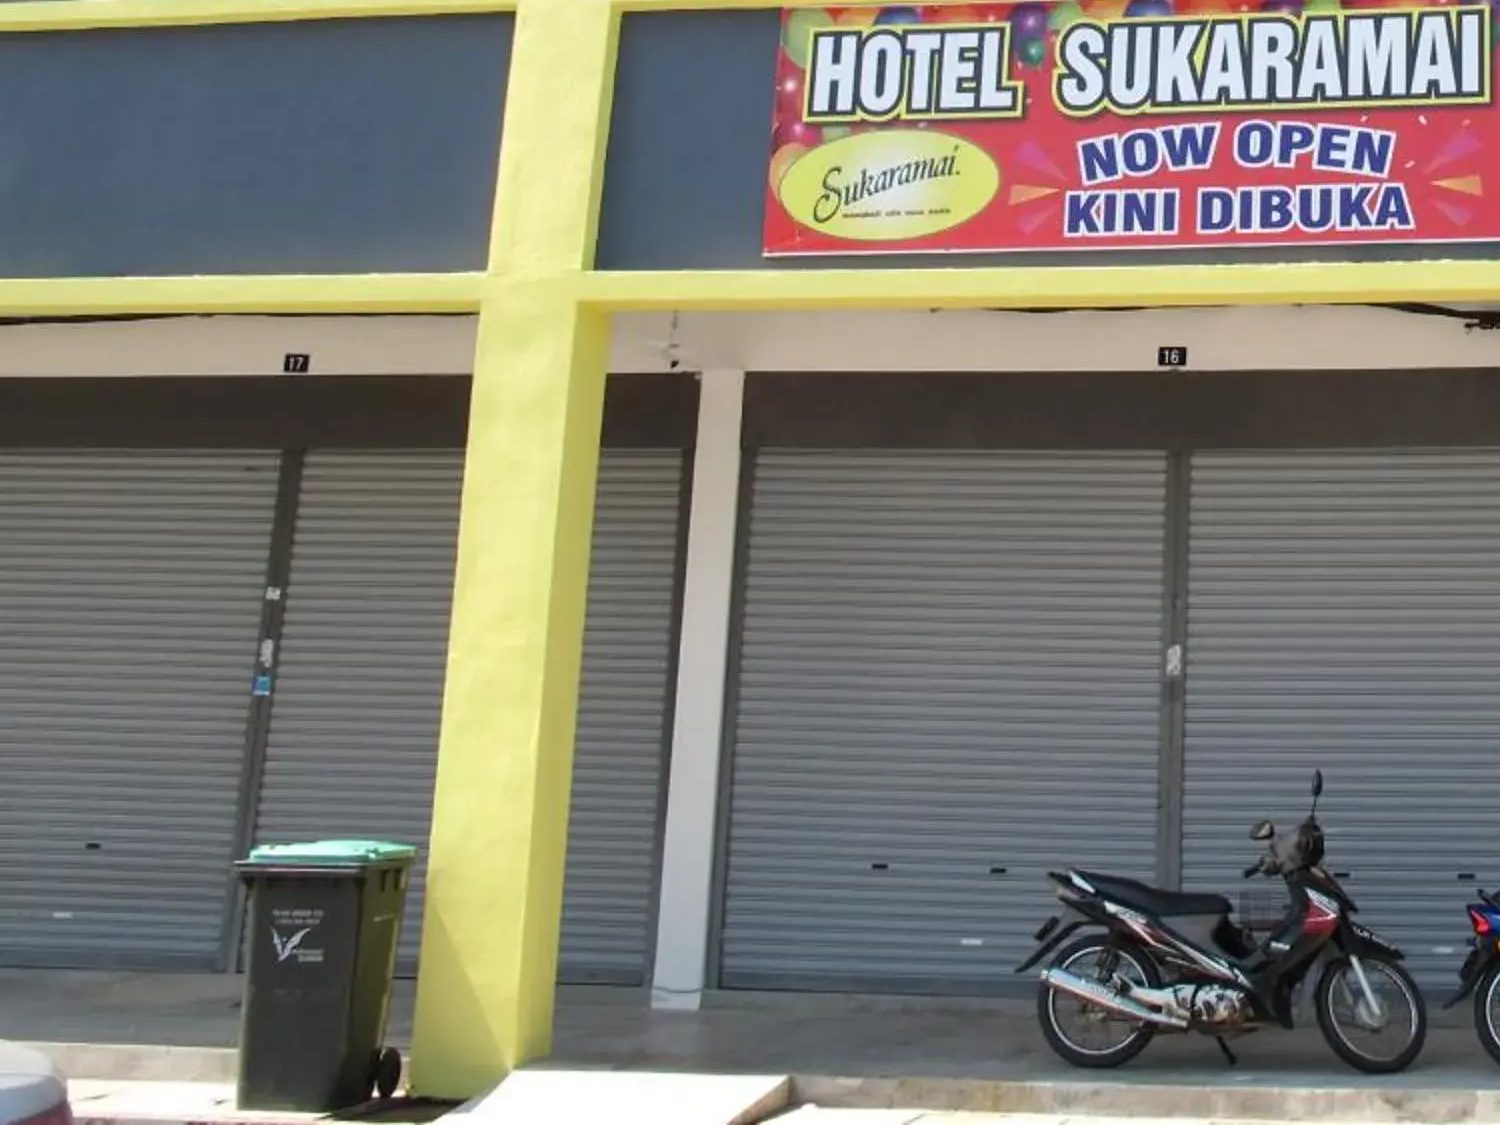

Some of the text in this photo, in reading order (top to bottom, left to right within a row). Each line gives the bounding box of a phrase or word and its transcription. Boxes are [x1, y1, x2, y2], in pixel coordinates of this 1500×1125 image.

[808, 9, 1485, 118] HOTEL SUKARAMAI
[1078, 119, 1396, 184] NOW OPEN
[1064, 183, 1416, 236] KINI DIBUKA
[1162, 348, 1181, 364] 16
